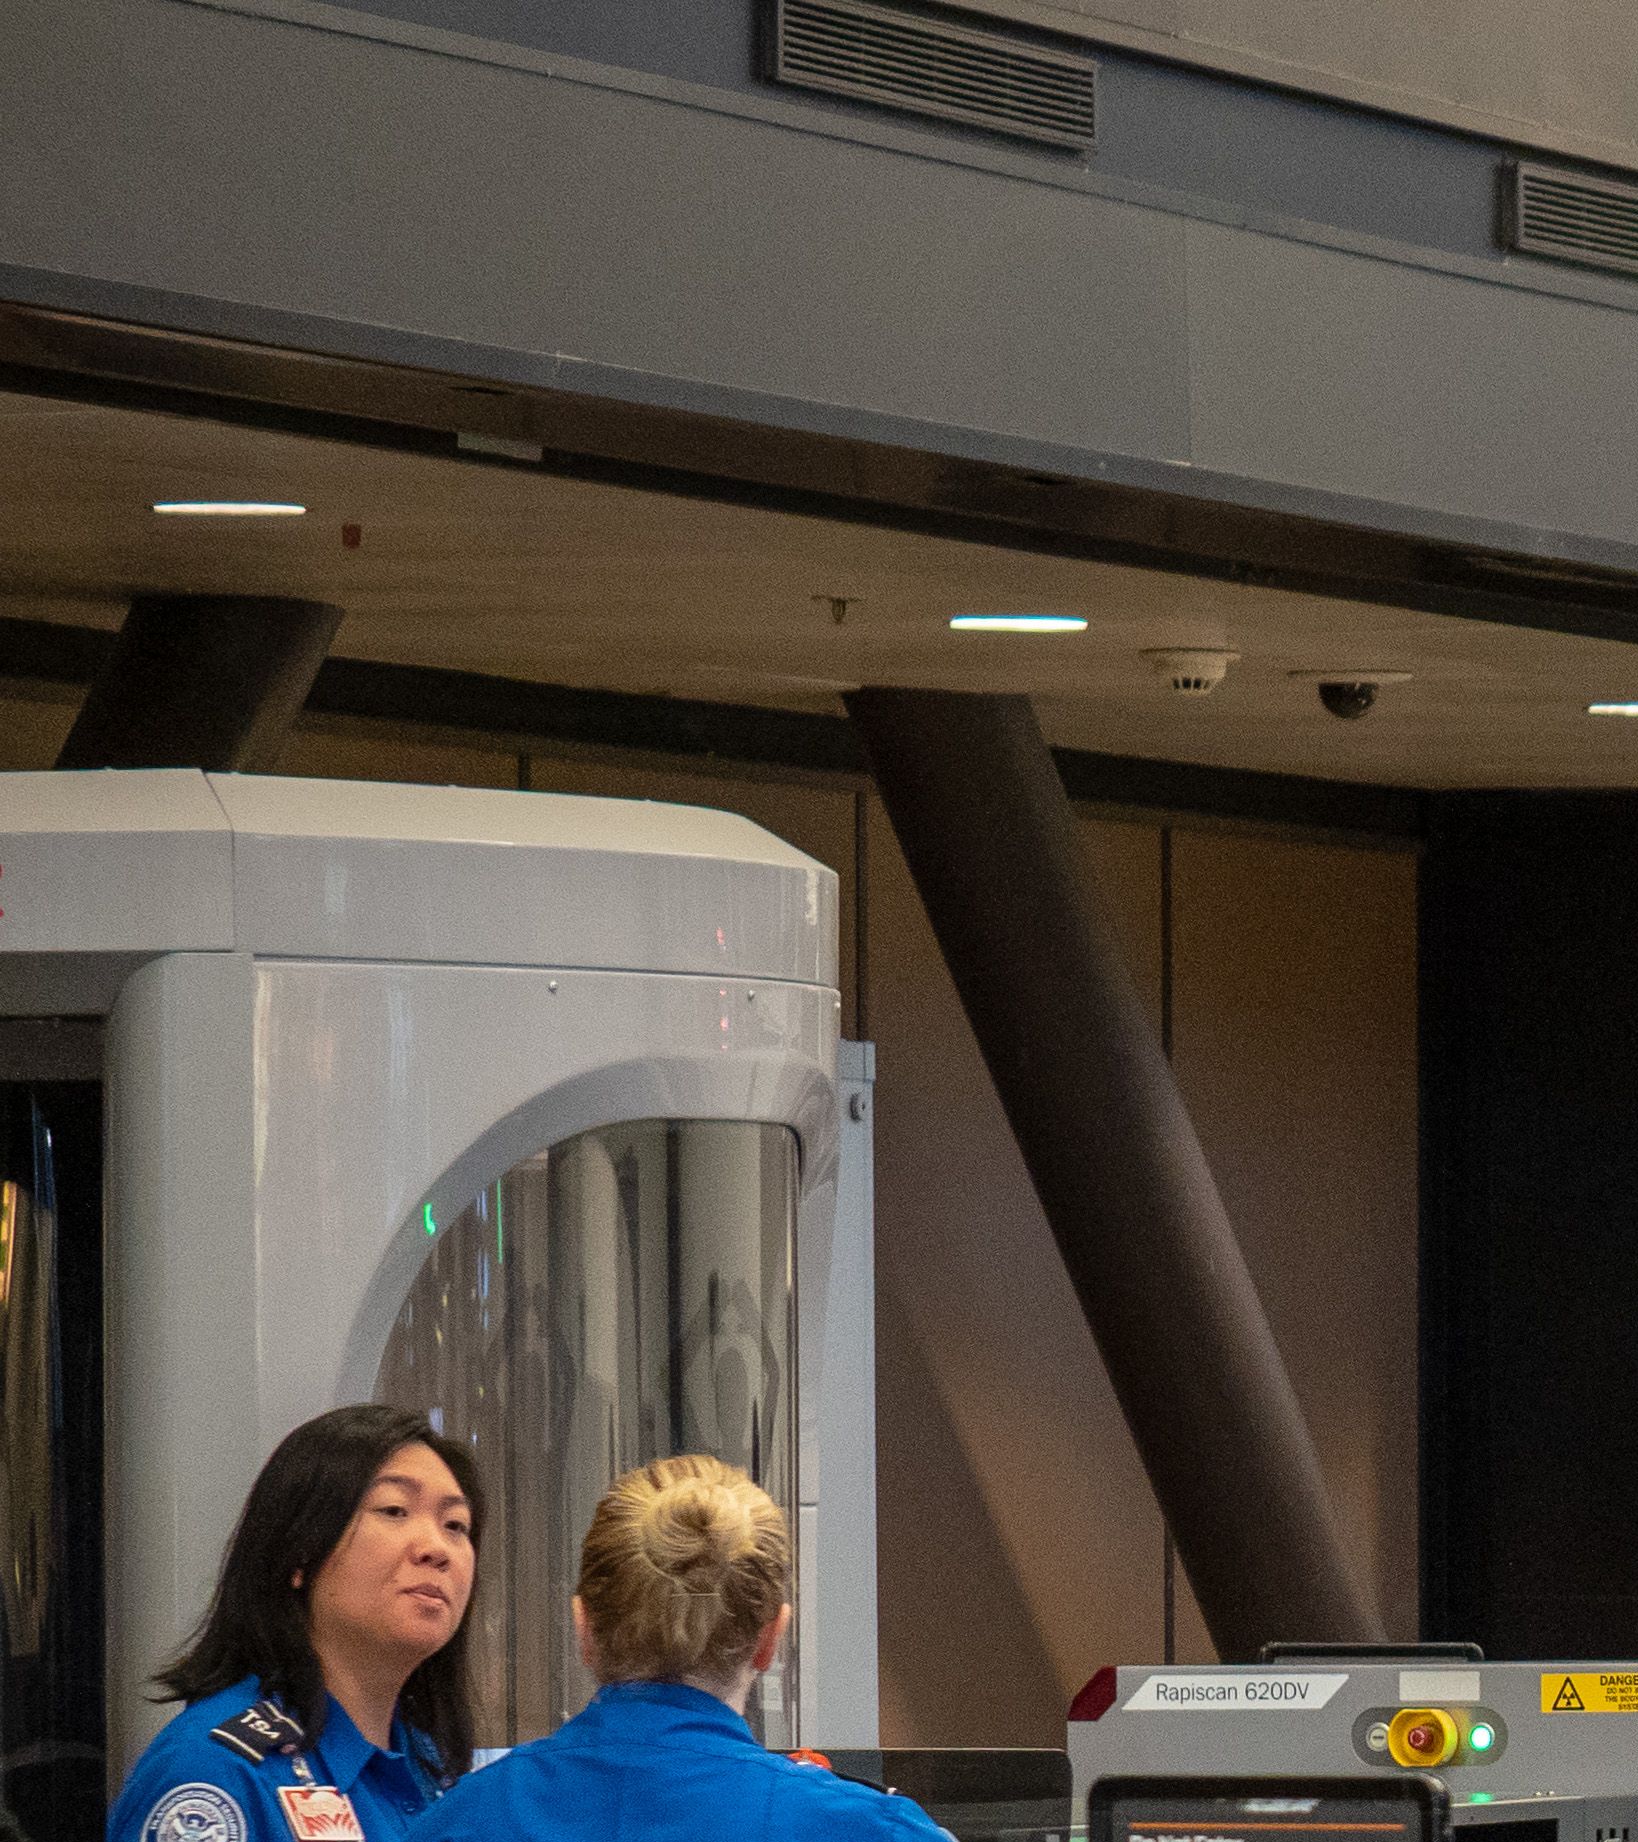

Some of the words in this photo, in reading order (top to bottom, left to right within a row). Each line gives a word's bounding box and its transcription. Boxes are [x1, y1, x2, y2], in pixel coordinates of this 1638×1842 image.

[1156, 1683, 1238, 1704] Rapiscan
[1245, 1681, 1310, 1701] 620DV
[240, 1708, 281, 1740] TSA
